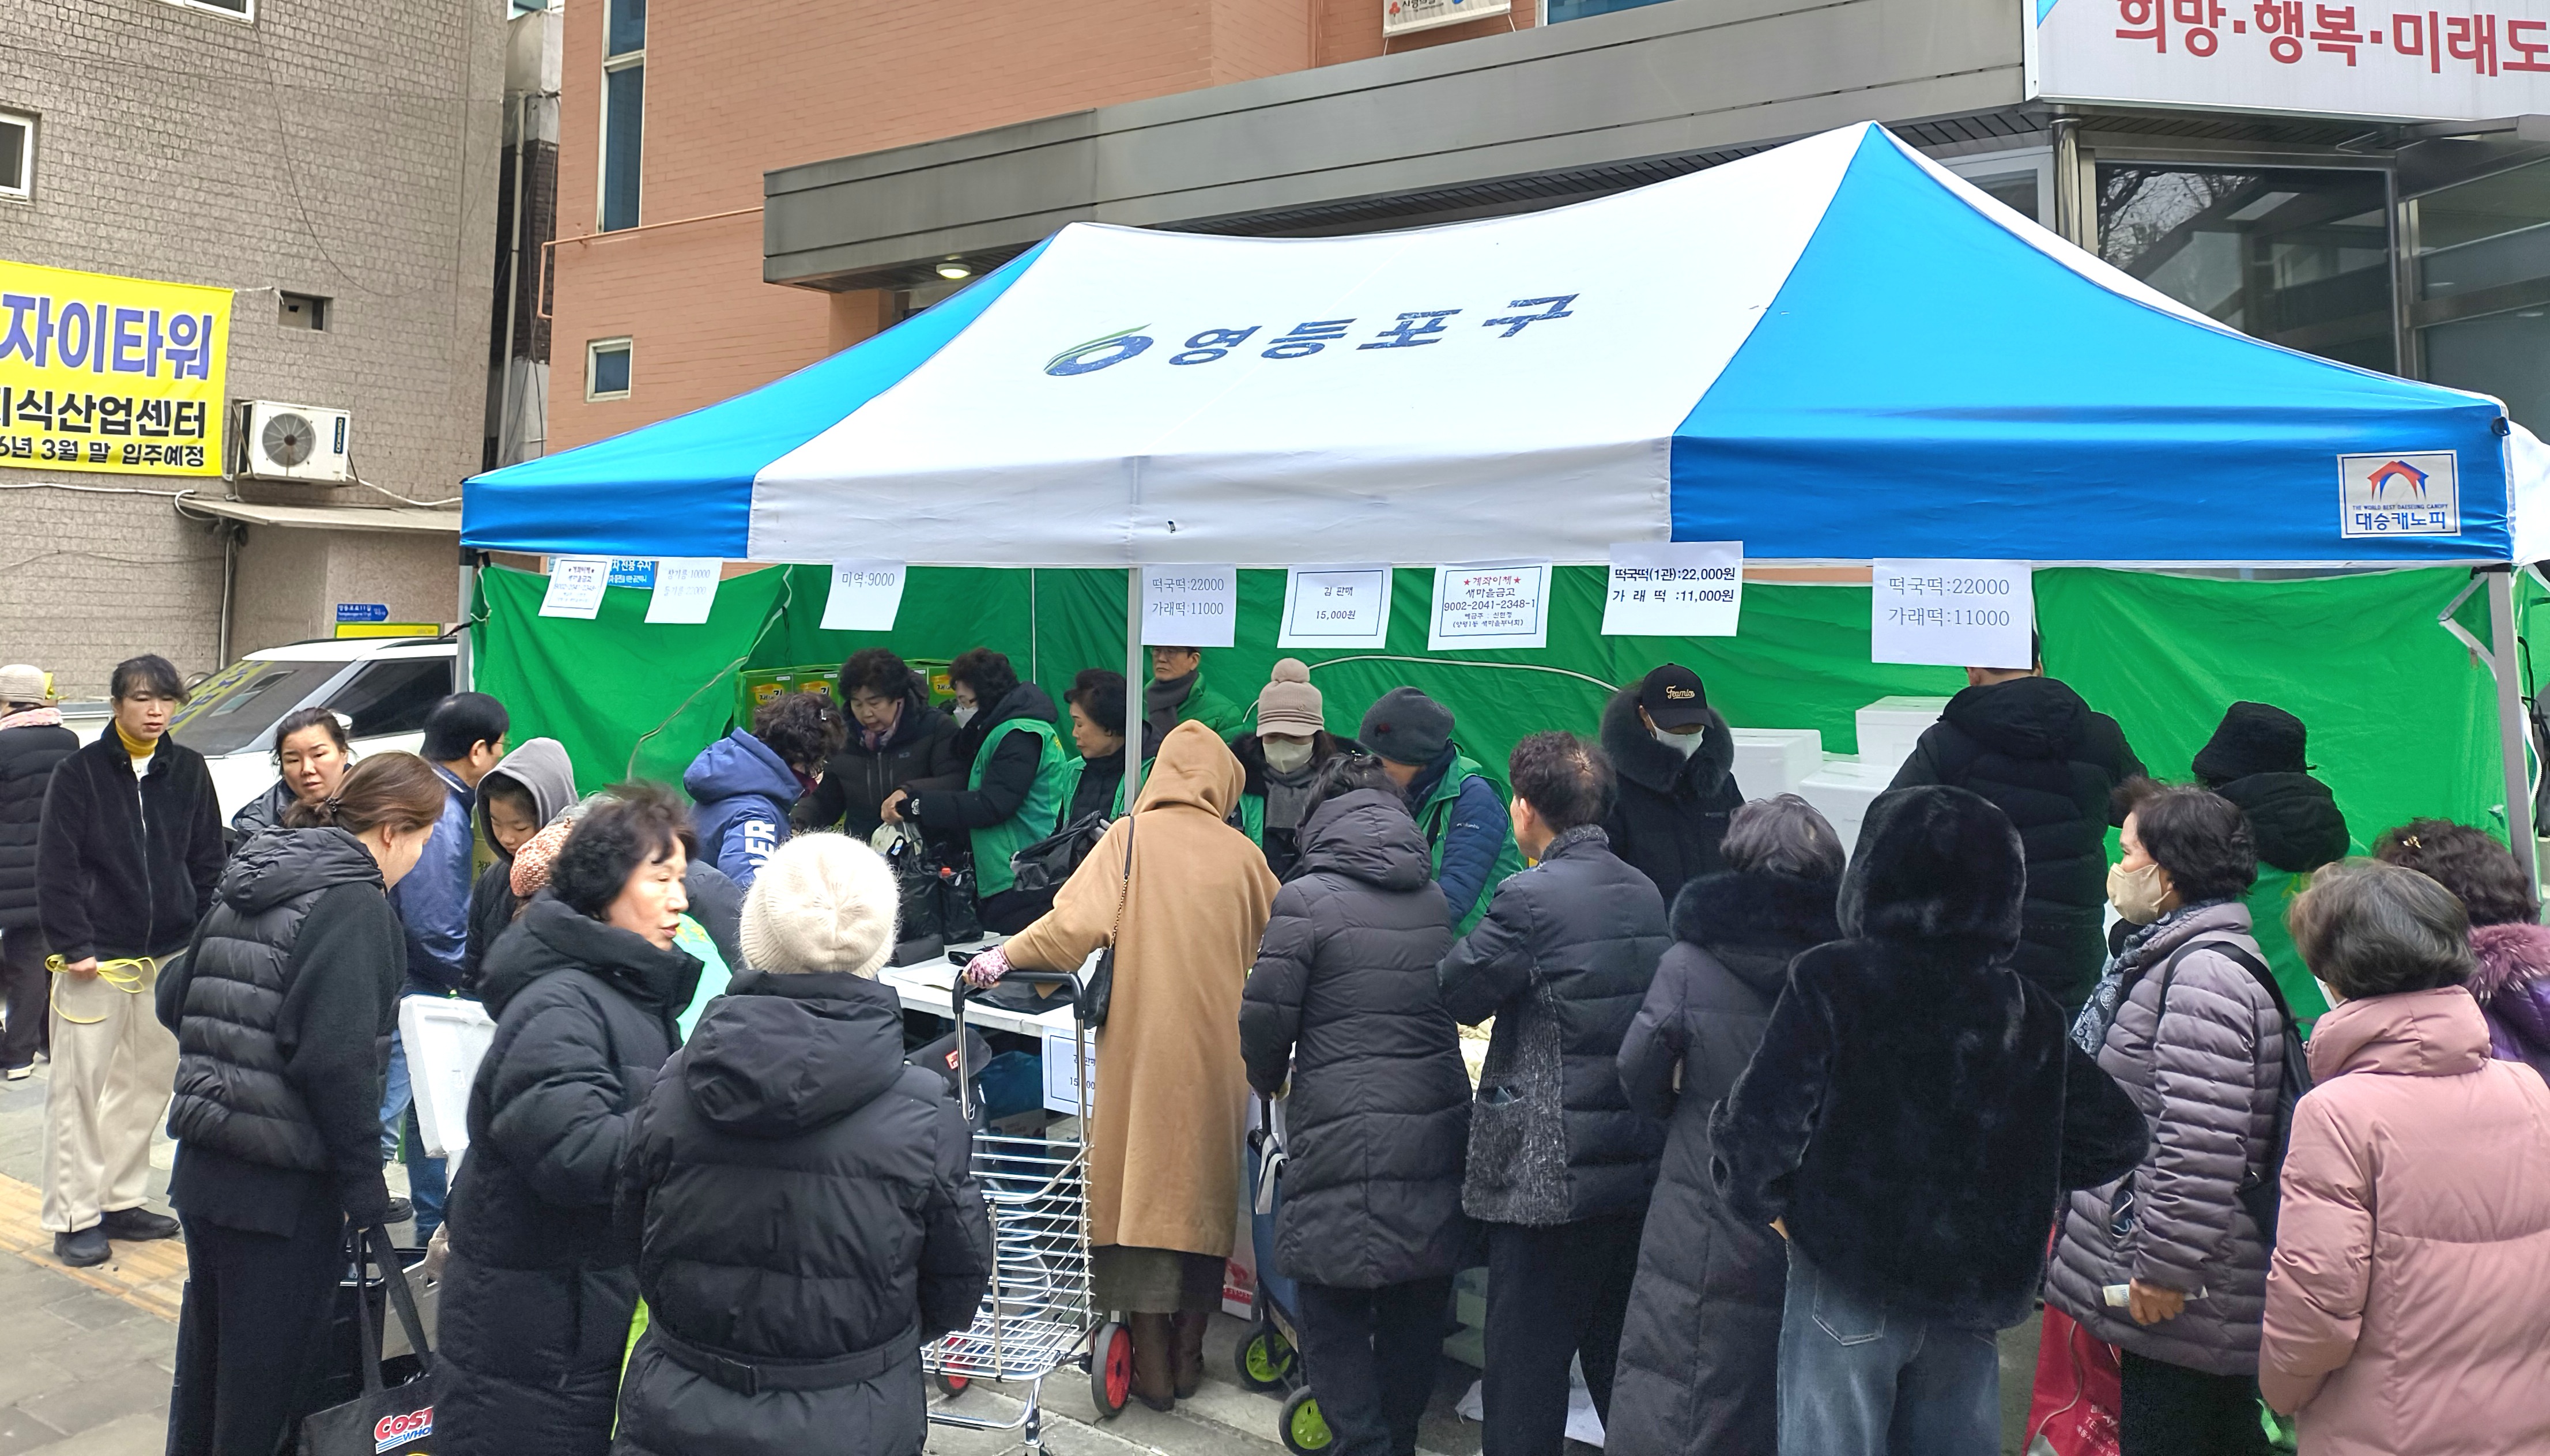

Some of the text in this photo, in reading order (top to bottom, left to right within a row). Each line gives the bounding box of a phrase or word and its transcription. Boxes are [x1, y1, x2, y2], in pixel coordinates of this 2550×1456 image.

[0, 294, 212, 380] 자이타워
[1168, 293, 1580, 365] 영등포구
[41, 439, 78, 462] 3월
[89, 442, 111, 463] 말
[122, 443, 204, 467] 입주예정
[2356, 511, 2446, 530] 대승캐노피
[842, 571, 895, 588] 미역:9000
[1615, 567, 1735, 582] 떡국떡(1관):22,000원
[1153, 578, 1224, 593] 떡국떡:22000
[1325, 587, 1353, 596] 김 판매
[1466, 587, 1515, 598] 새마을금고
[1889, 577, 2009, 596] 떡국떡:22000
[1152, 601, 1223, 616] 가래떡:11000
[1444, 599, 1535, 611] 9002-2041-2348-1
[1317, 610, 1356, 620] 15,000원
[1888, 607, 2009, 627] 가래떡:11000
